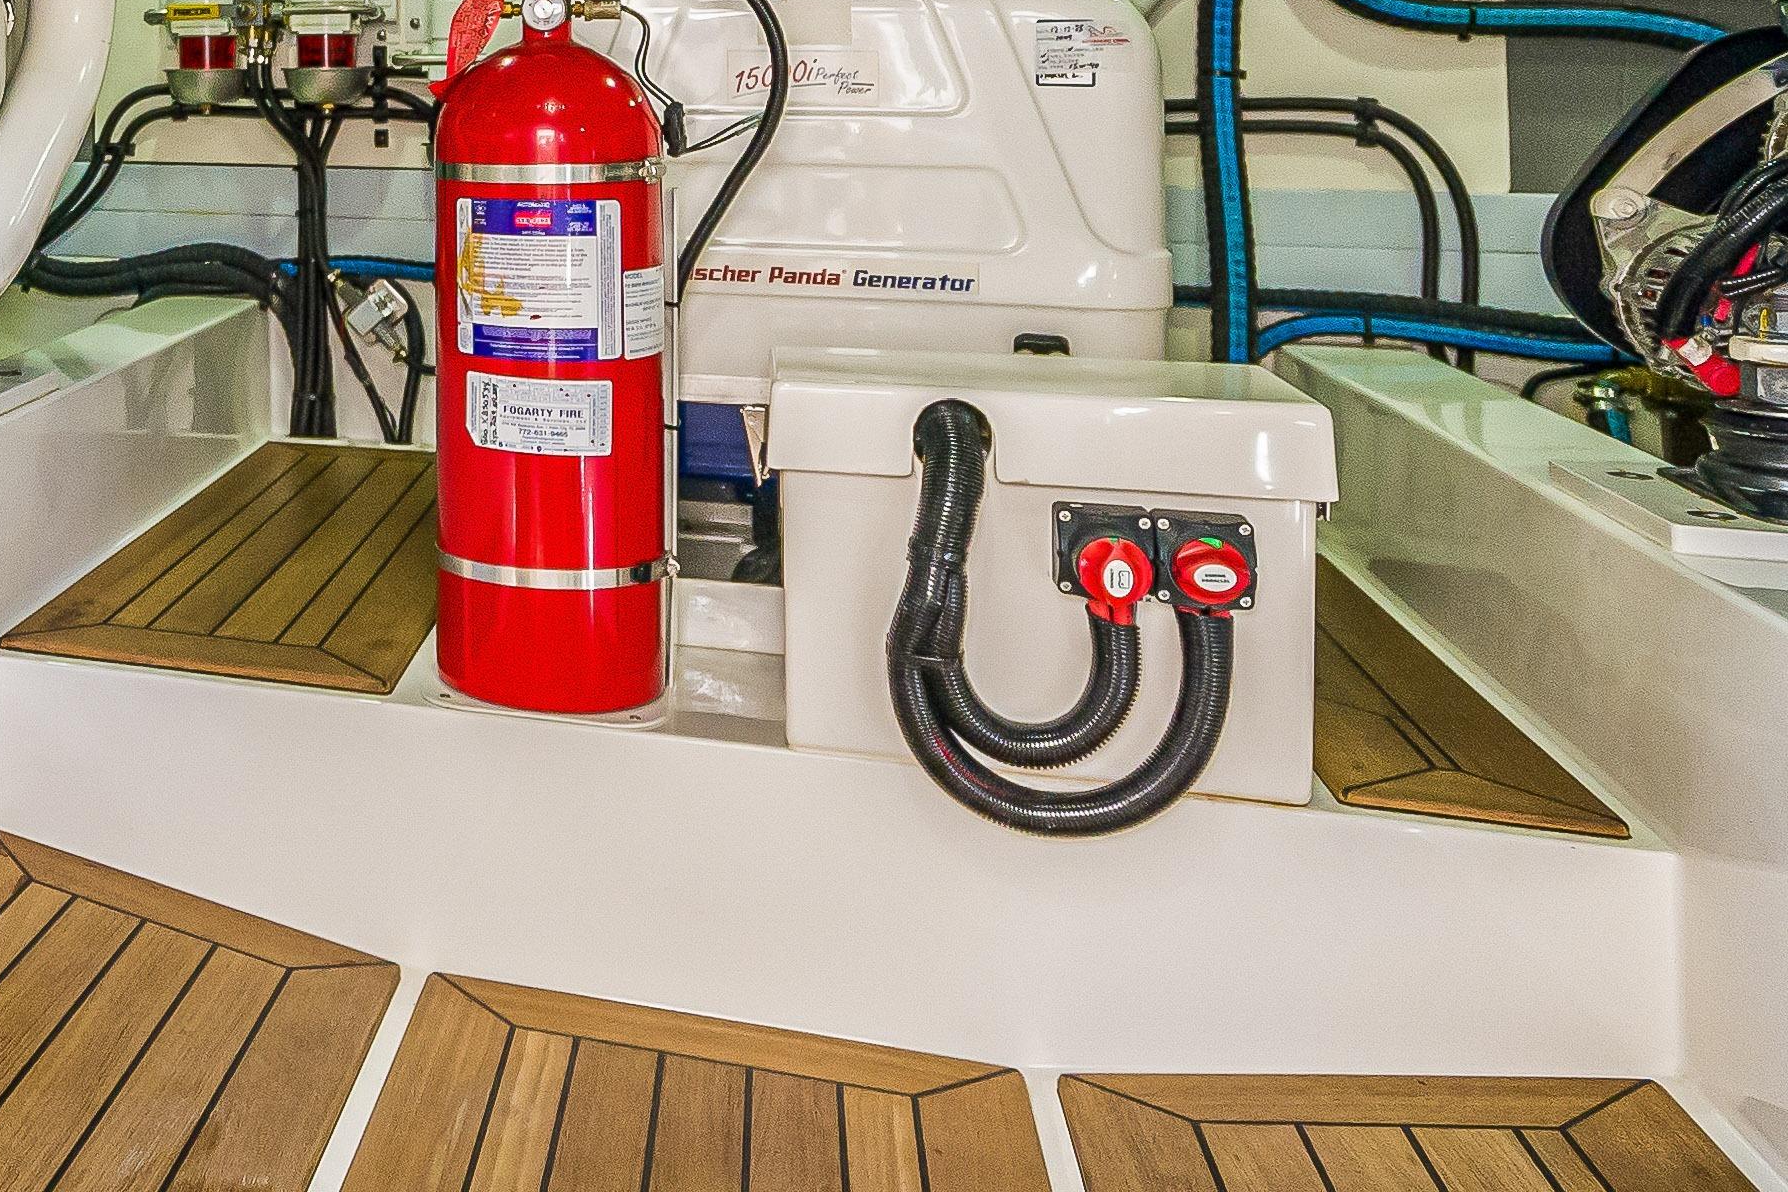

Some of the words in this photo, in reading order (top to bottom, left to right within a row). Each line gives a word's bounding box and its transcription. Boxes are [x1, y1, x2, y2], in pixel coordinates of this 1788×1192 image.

[735, 58, 818, 94] 1500i
[814, 67, 860, 85] Perfect
[837, 81, 872, 95] Power
[689, 264, 762, 283] ischer
[768, 266, 842, 287] Panda
[852, 269, 976, 292] Generator
[503, 405, 554, 418] FOGARTY
[559, 409, 584, 419] FIRE
